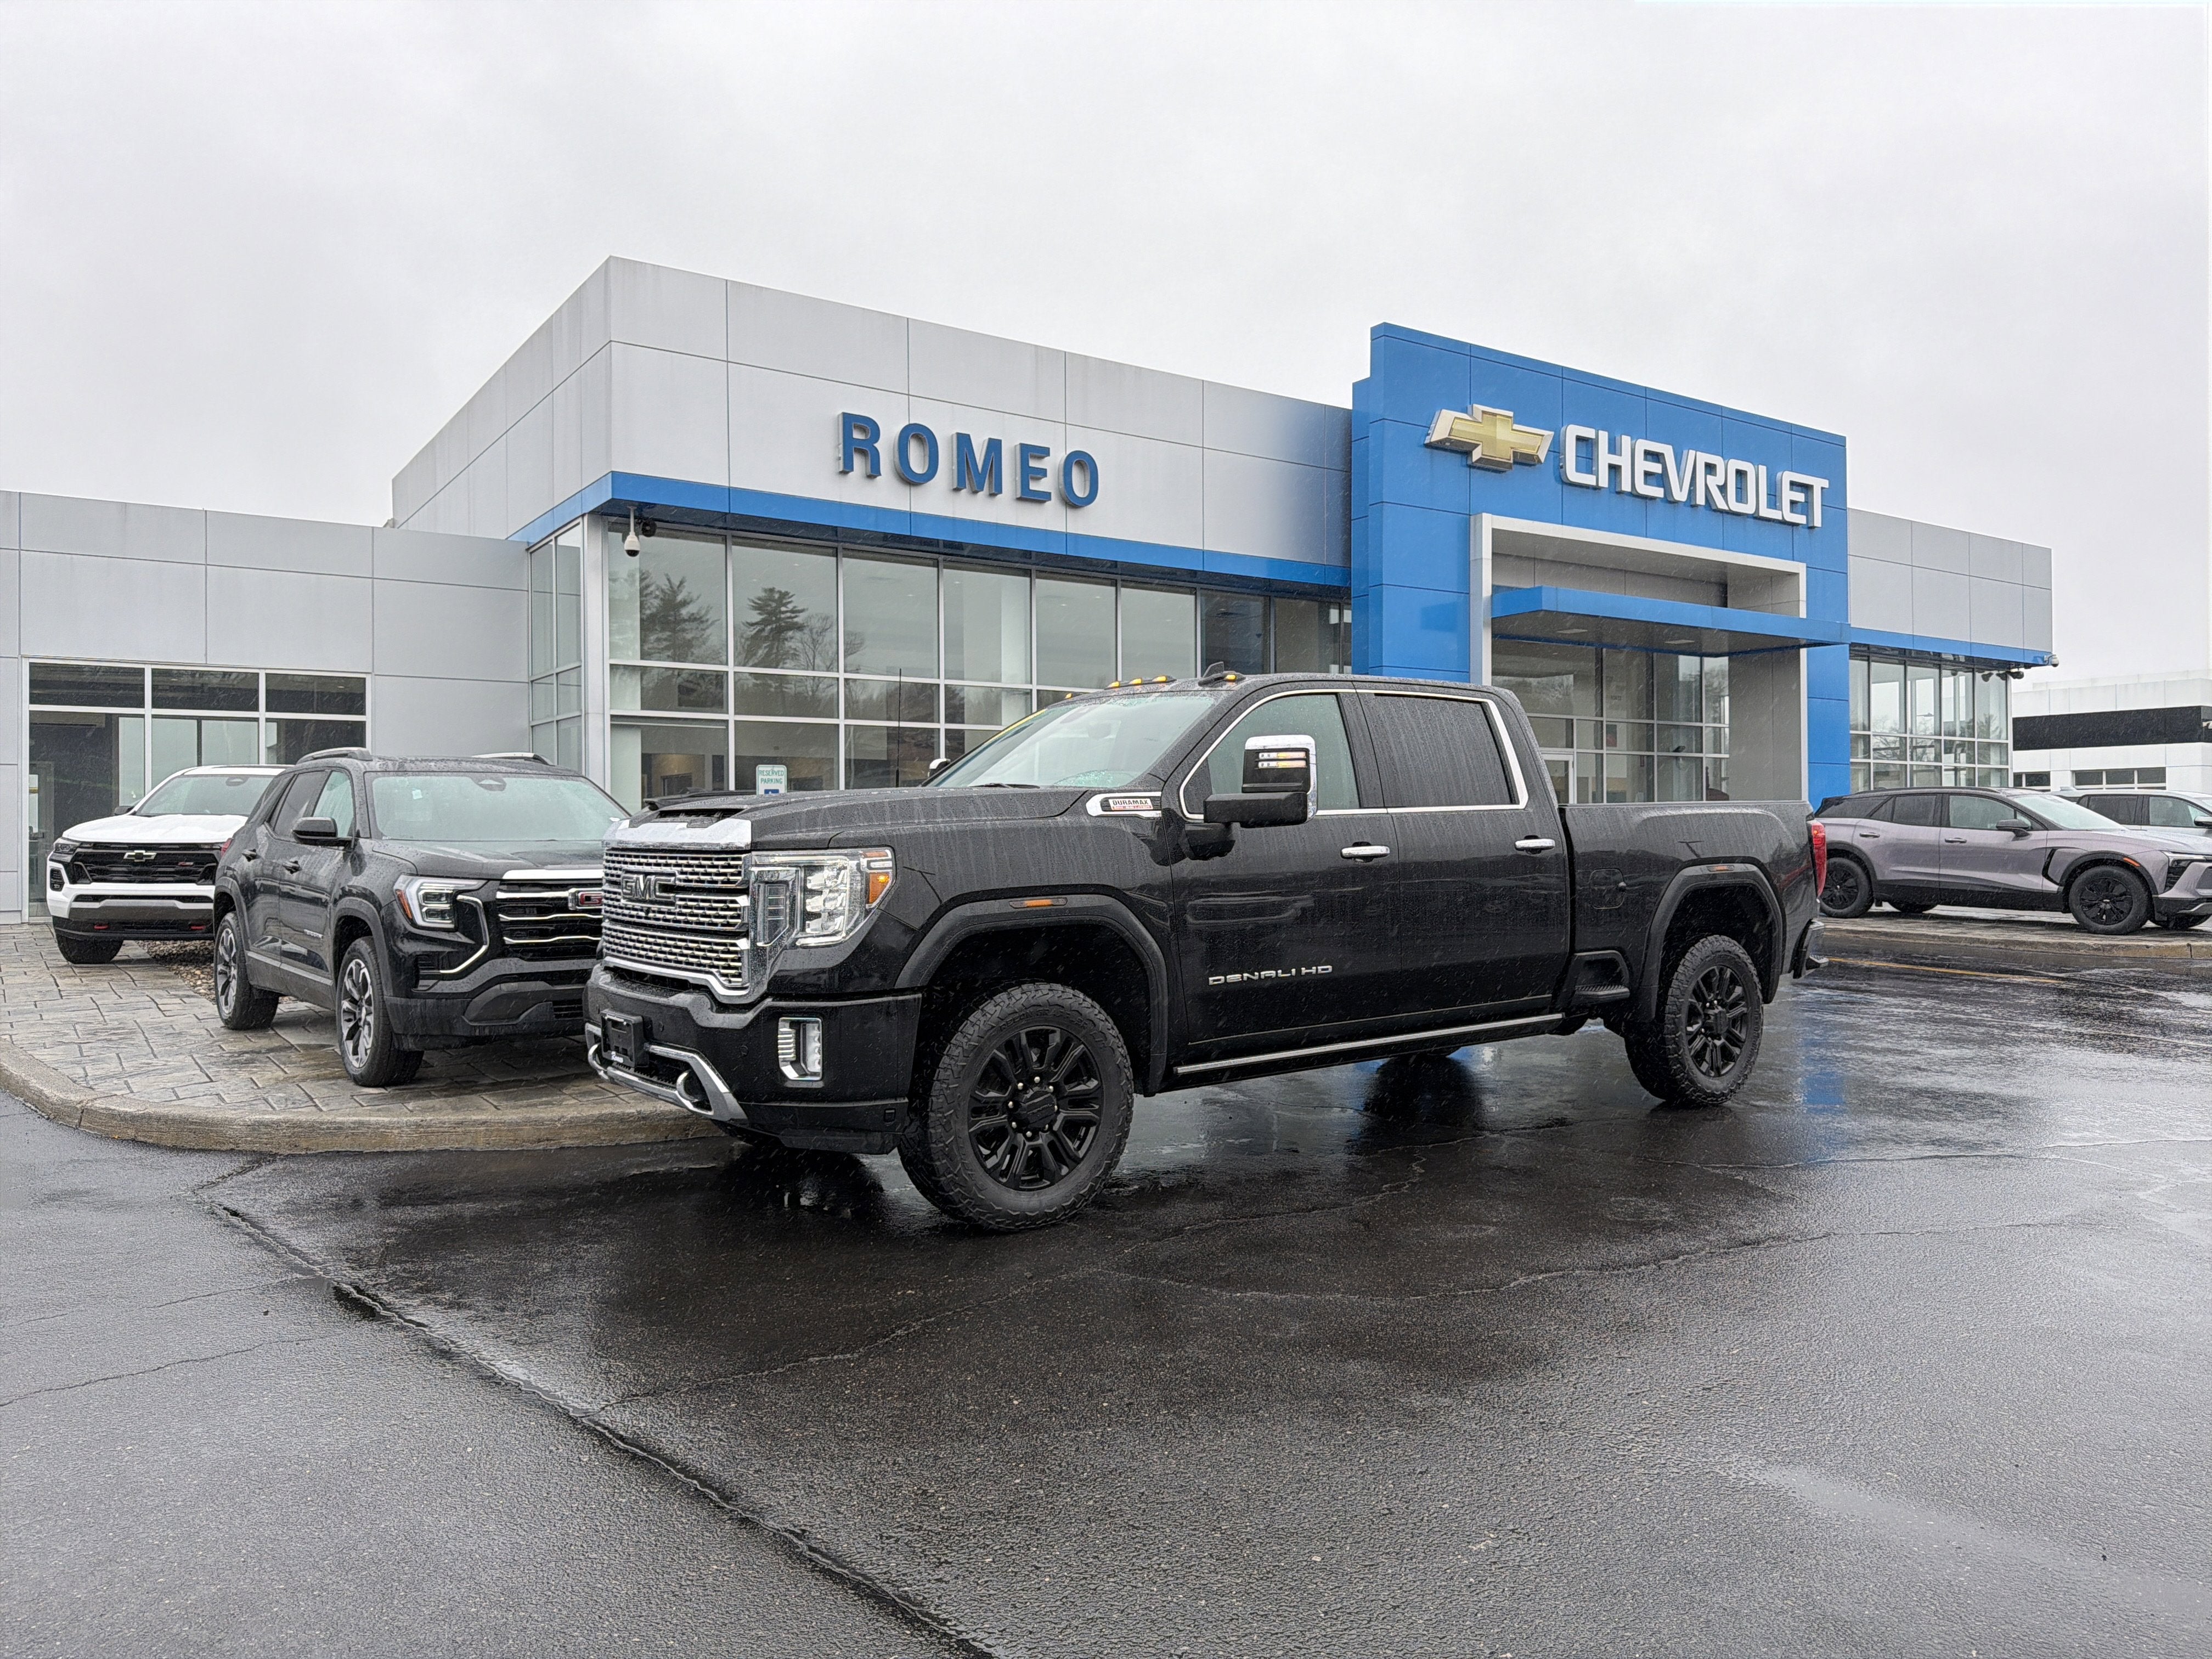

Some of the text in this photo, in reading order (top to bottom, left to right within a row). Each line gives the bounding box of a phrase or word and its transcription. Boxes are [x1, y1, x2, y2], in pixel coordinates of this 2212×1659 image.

[838, 411, 1099, 508] ROMEO
[1560, 424, 1829, 528] CHEVROLET
[621, 874, 676, 901] GMC
[1208, 965, 1333, 986] DENALI HD
